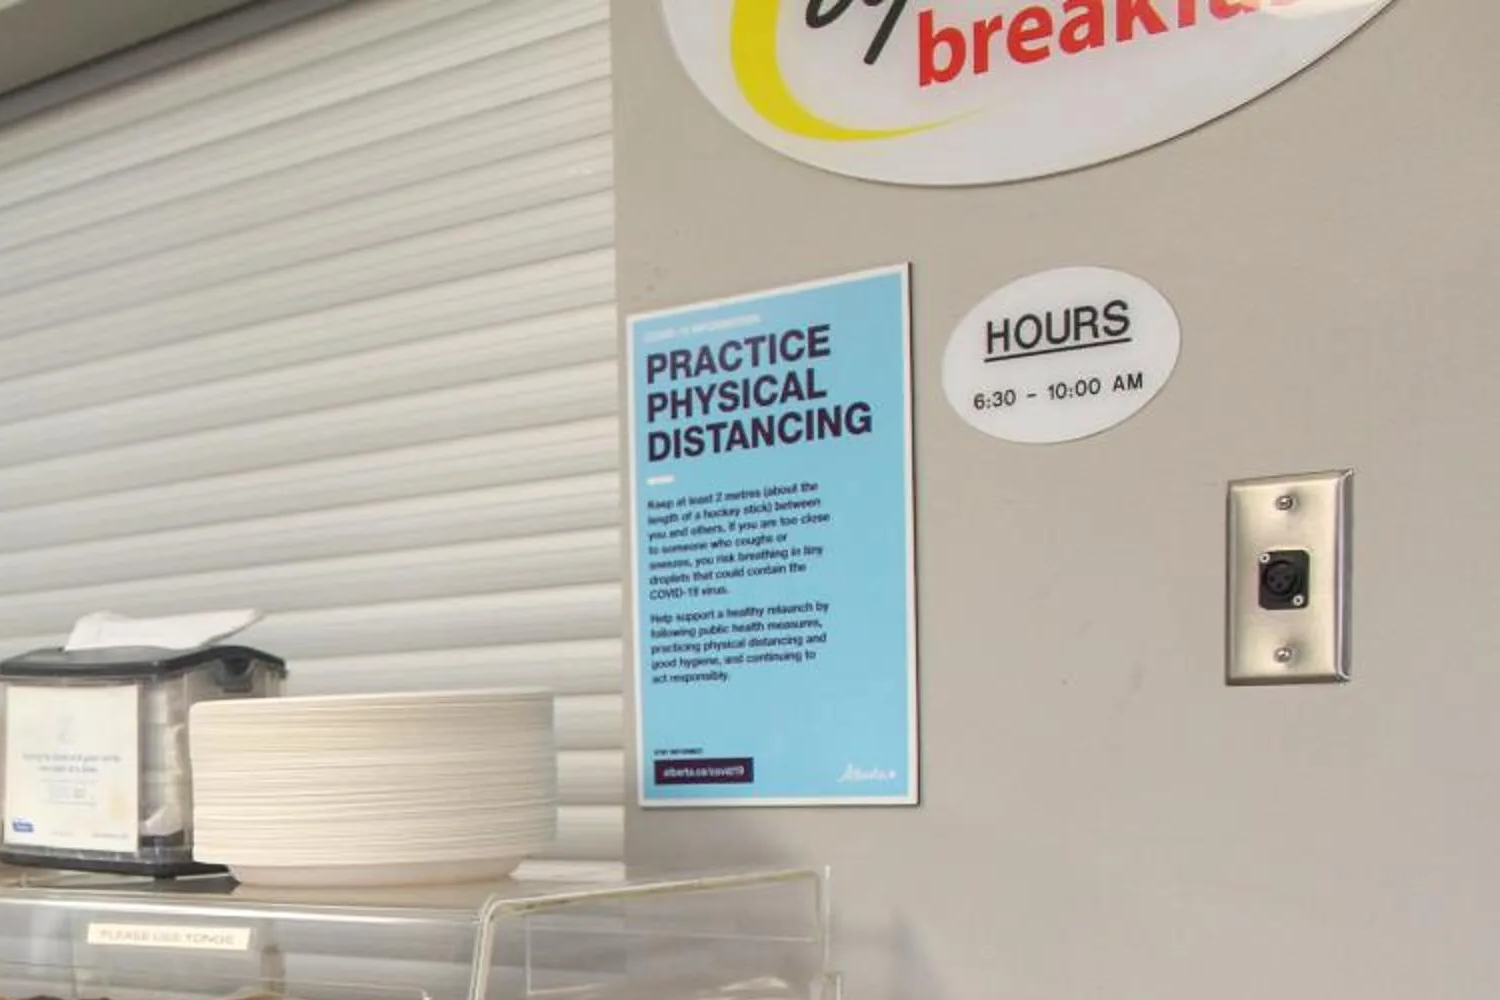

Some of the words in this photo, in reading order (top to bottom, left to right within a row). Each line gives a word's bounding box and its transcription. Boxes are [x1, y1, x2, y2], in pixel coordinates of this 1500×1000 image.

[987, 300, 1131, 354] HOURS
[647, 324, 831, 385] PRACTICE
[647, 367, 828, 423] PHYSICAL
[974, 389, 1016, 410] 6:30
[1048, 377, 1100, 400] 10:00
[1112, 372, 1143, 391] AM
[648, 401, 873, 463] DISTANCING
[800, 481, 818, 492] the
[648, 513, 679, 526] length
[703, 507, 740, 519] hockey
[775, 498, 821, 511] between
[649, 531, 666, 541] you
[669, 527, 688, 537] and
[738, 521, 757, 532] you
[760, 519, 776, 528] are
[780, 515, 798, 526] too
[801, 513, 830, 525] close
[662, 542, 708, 554] someone
[711, 538, 732, 550] who
[735, 534, 773, 547] coughs
[695, 556, 714, 568] you
[716, 554, 734, 563] risk
[738, 548, 788, 561] breathing
[803, 545, 823, 556] tiny
[650, 573, 690, 586] droplets
[693, 570, 713, 581] that
[716, 568, 744, 579] could
[747, 564, 786, 576] contain
[790, 563, 806, 573] the
[650, 587, 699, 600] COVID-19
[651, 614, 673, 624] Help
[676, 610, 715, 623] support
[726, 606, 764, 619] healthy
[767, 602, 813, 615] relaunch
[651, 626, 696, 639] following
[698, 623, 730, 637] public
[732, 620, 764, 632] health
[651, 642, 702, 655] practicing
[704, 638, 745, 652] physical
[748, 635, 803, 648] distancing
[806, 632, 827, 643] and
[652, 658, 677, 671] good
[724, 654, 744, 664] and
[746, 650, 802, 664] continuing
[652, 673, 667, 683] act
